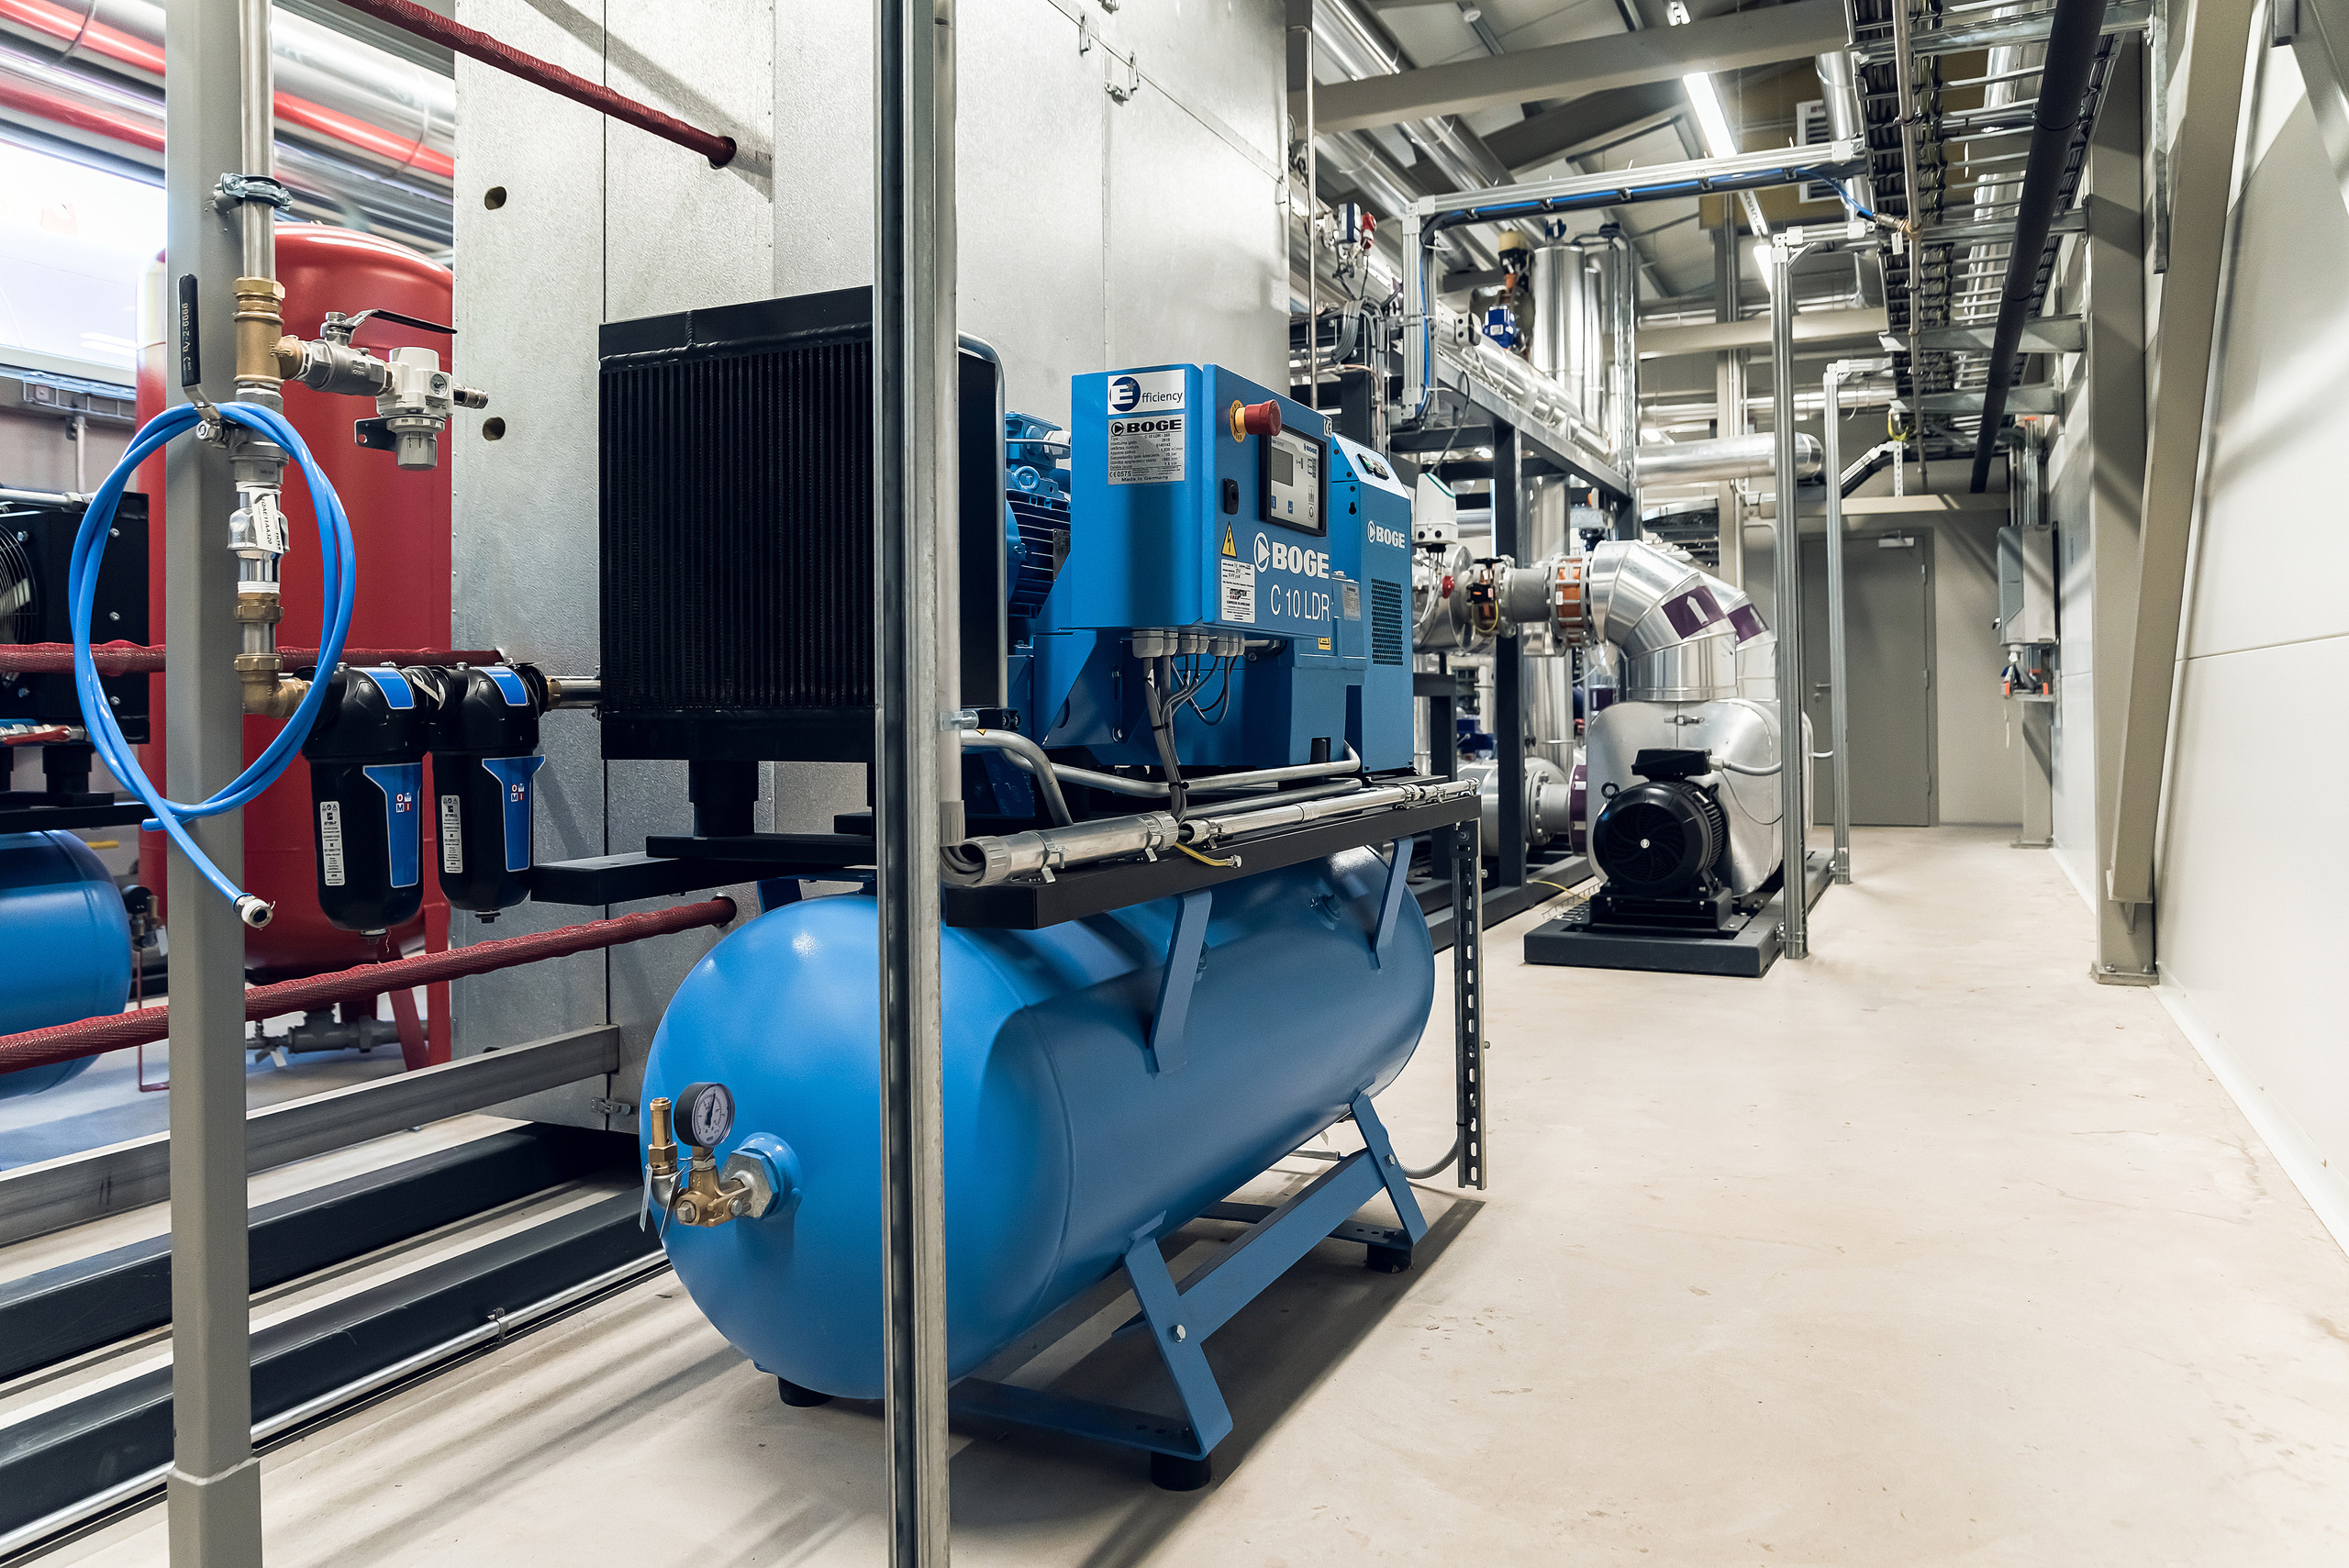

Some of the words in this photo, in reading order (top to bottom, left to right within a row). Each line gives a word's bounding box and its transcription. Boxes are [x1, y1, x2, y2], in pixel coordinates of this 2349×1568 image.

[1127, 419, 1182, 433] BOGE
[1376, 525, 1406, 550] BOGE
[1272, 541, 1330, 579] BOGE
[1271, 584, 1281, 616] C
[1286, 588, 1301, 618] 10
[1304, 590, 1330, 622] LDR
